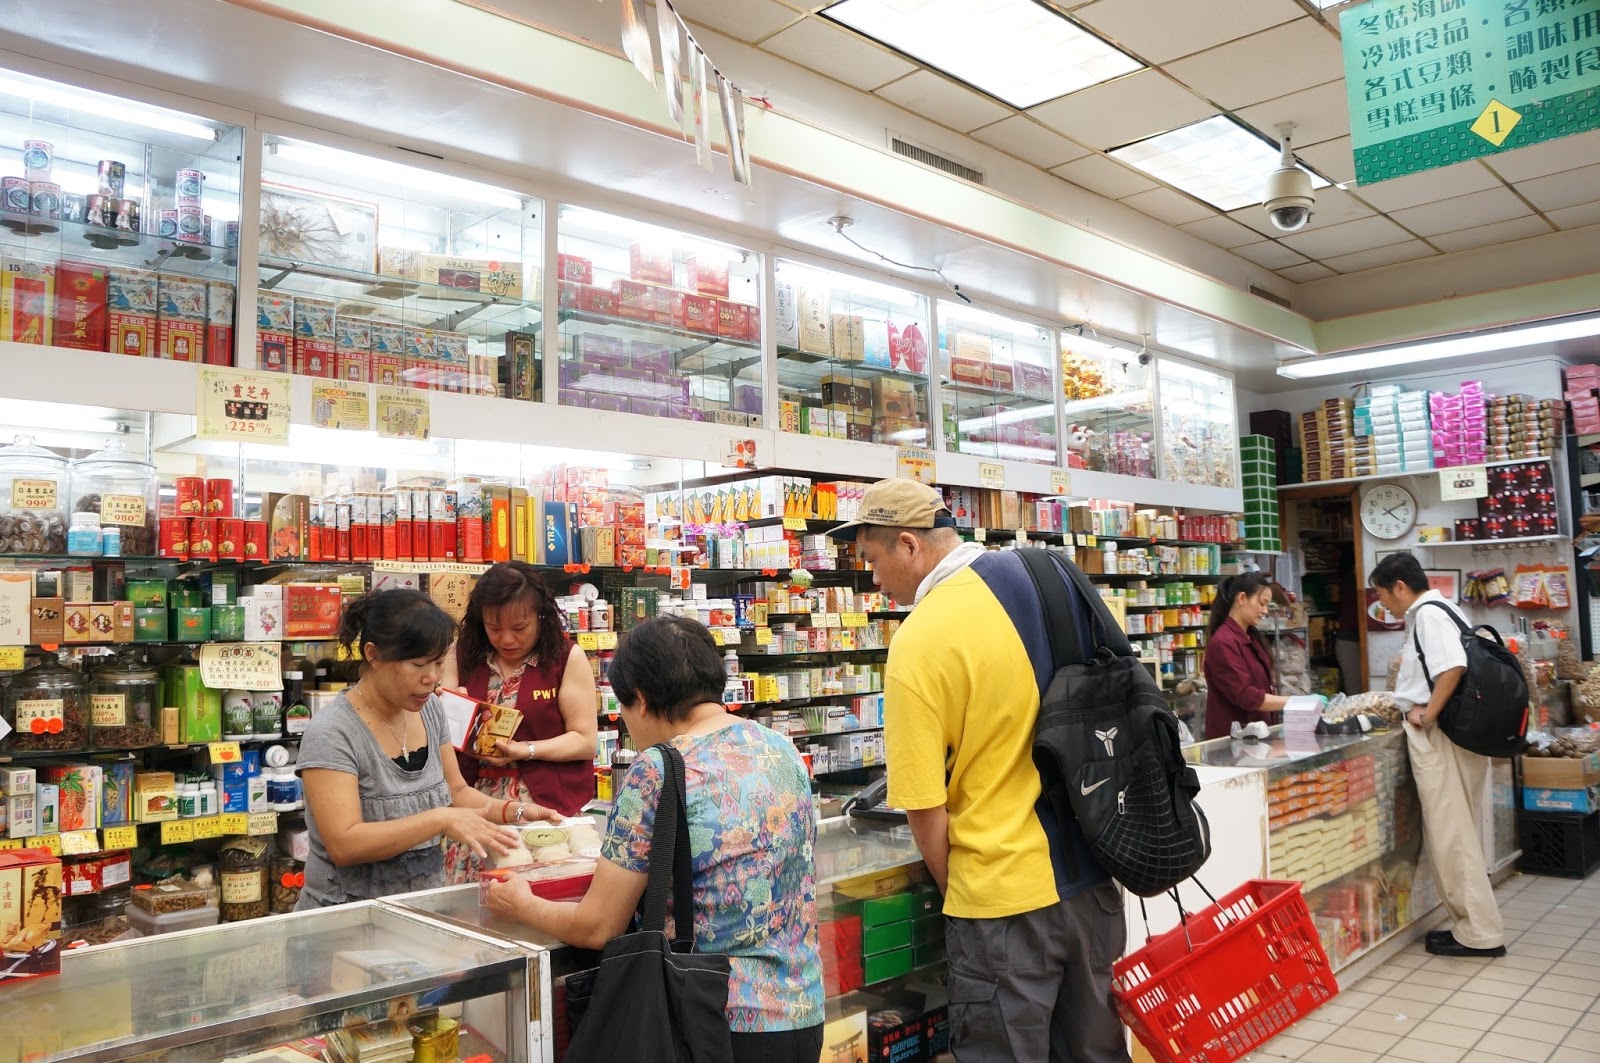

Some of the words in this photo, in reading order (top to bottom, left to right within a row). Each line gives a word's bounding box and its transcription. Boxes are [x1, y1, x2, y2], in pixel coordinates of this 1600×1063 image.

[1360, 17, 1469, 70] 冷凍食品
[1504, 0, 1600, 27] 各類
[1364, 49, 1473, 101] 各式豆類
[1366, 83, 1476, 133] 雪糕雪條
[1490, 110, 1504, 135] 1
[9, 263, 21, 272] 15
[263, 334, 286, 343] 正官庄
[232, 384, 271, 400] 靈芝丹
[230, 420, 255, 433] 225
[1385, 490, 1392, 498] 12
[26, 499, 47, 507] 999
[1368, 508, 1374, 516] 9
[1403, 508, 1409, 516] 3
[1371, 517, 1376, 525] 8
[1377, 523, 1383, 531] 7
[1394, 523, 1400, 531] 5
